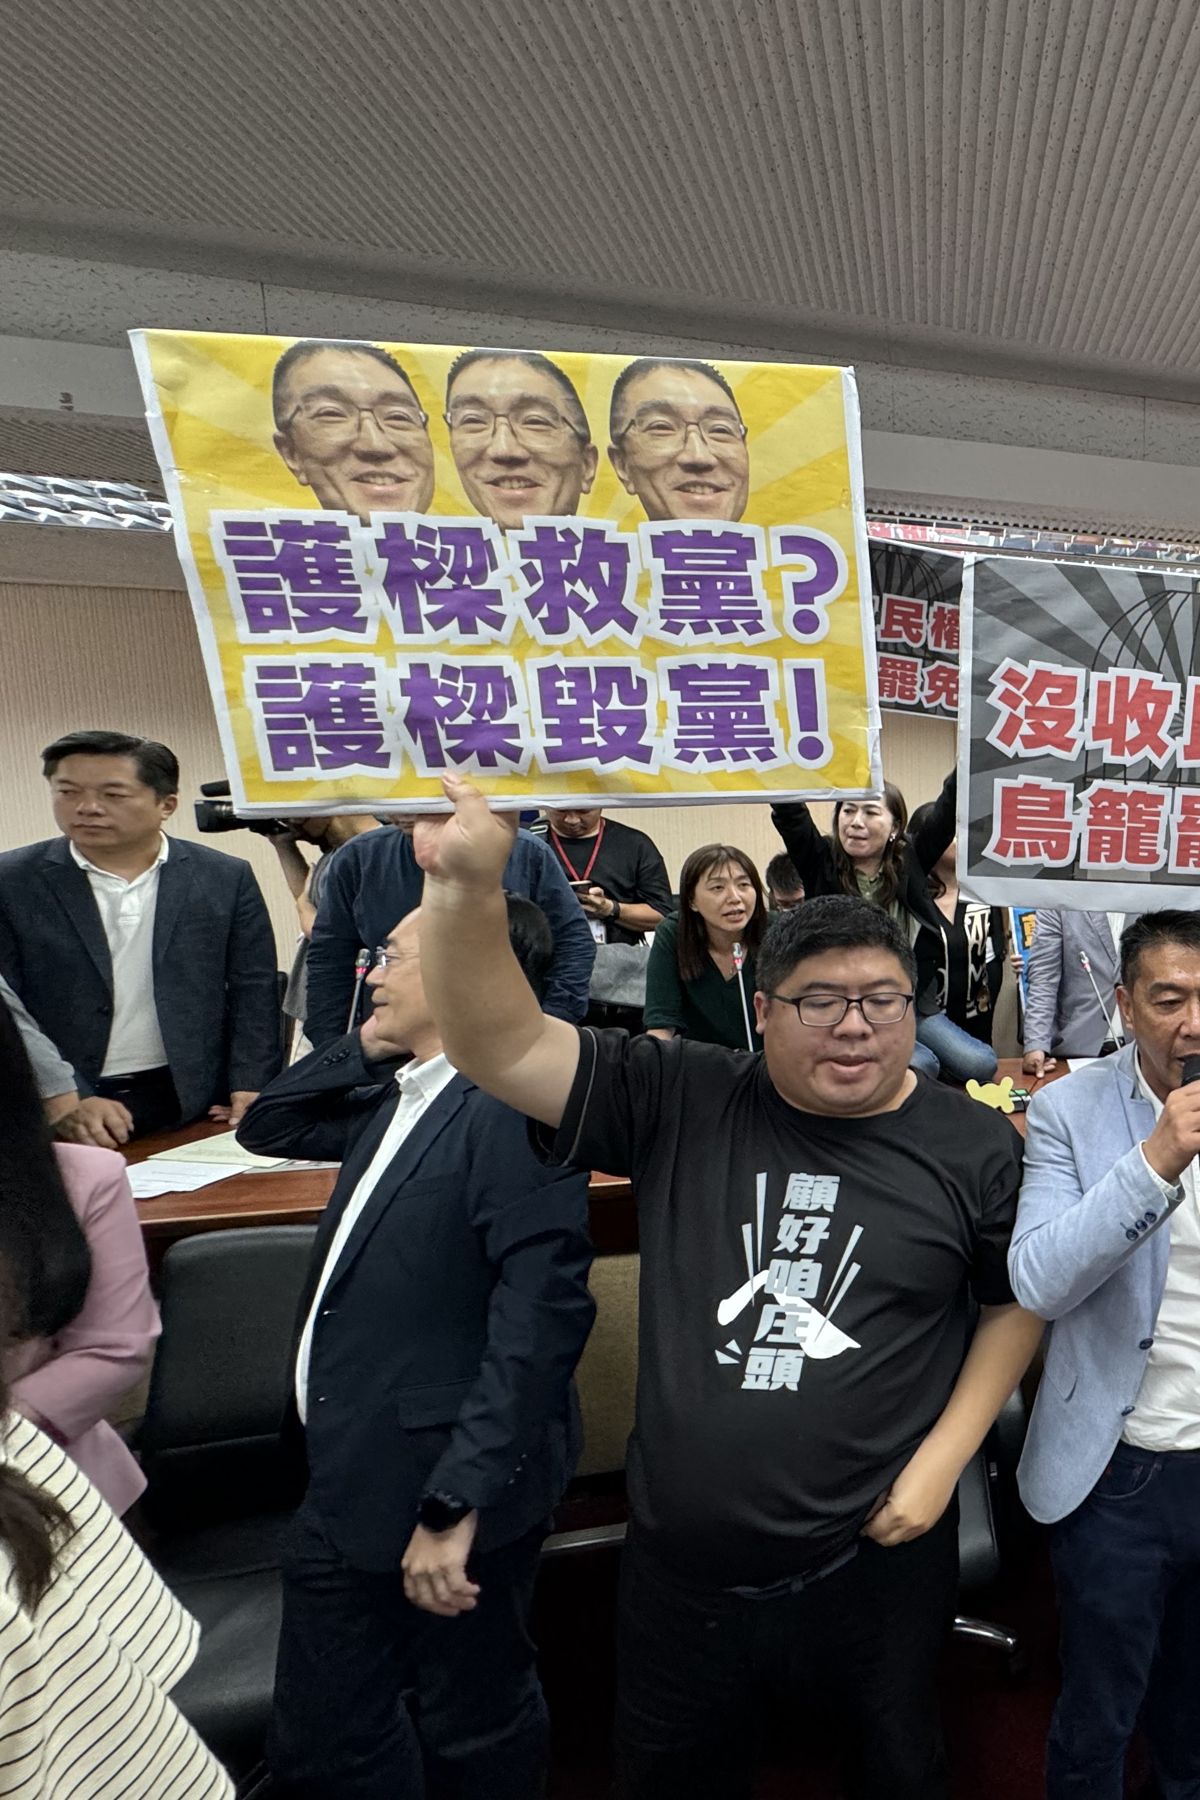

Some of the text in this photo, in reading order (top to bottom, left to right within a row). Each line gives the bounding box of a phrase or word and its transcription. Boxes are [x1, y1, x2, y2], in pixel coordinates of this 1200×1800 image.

[221, 518, 841, 639] 護樑救黨?
[253, 660, 826, 773] 護樑毀黨!
